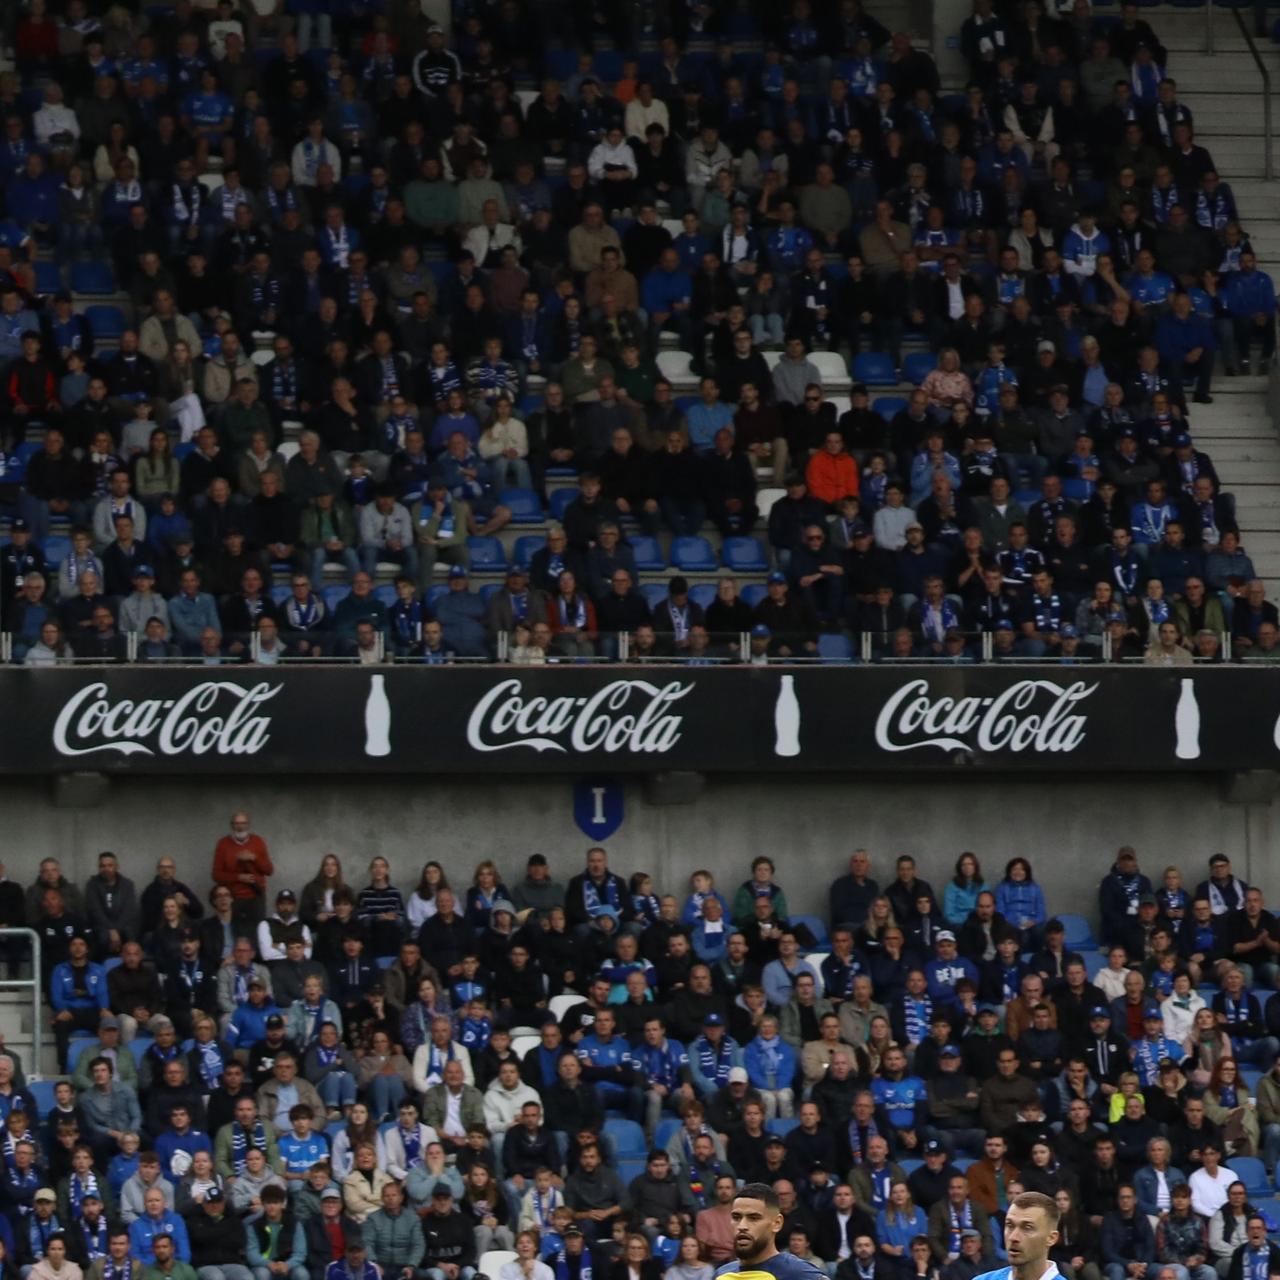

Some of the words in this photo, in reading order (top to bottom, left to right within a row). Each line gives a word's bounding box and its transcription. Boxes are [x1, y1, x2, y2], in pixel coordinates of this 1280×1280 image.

[53, 682, 283, 755] Coca-Cola
[468, 679, 694, 752] Coca-Cola
[876, 680, 1098, 752] Coca-Cola
